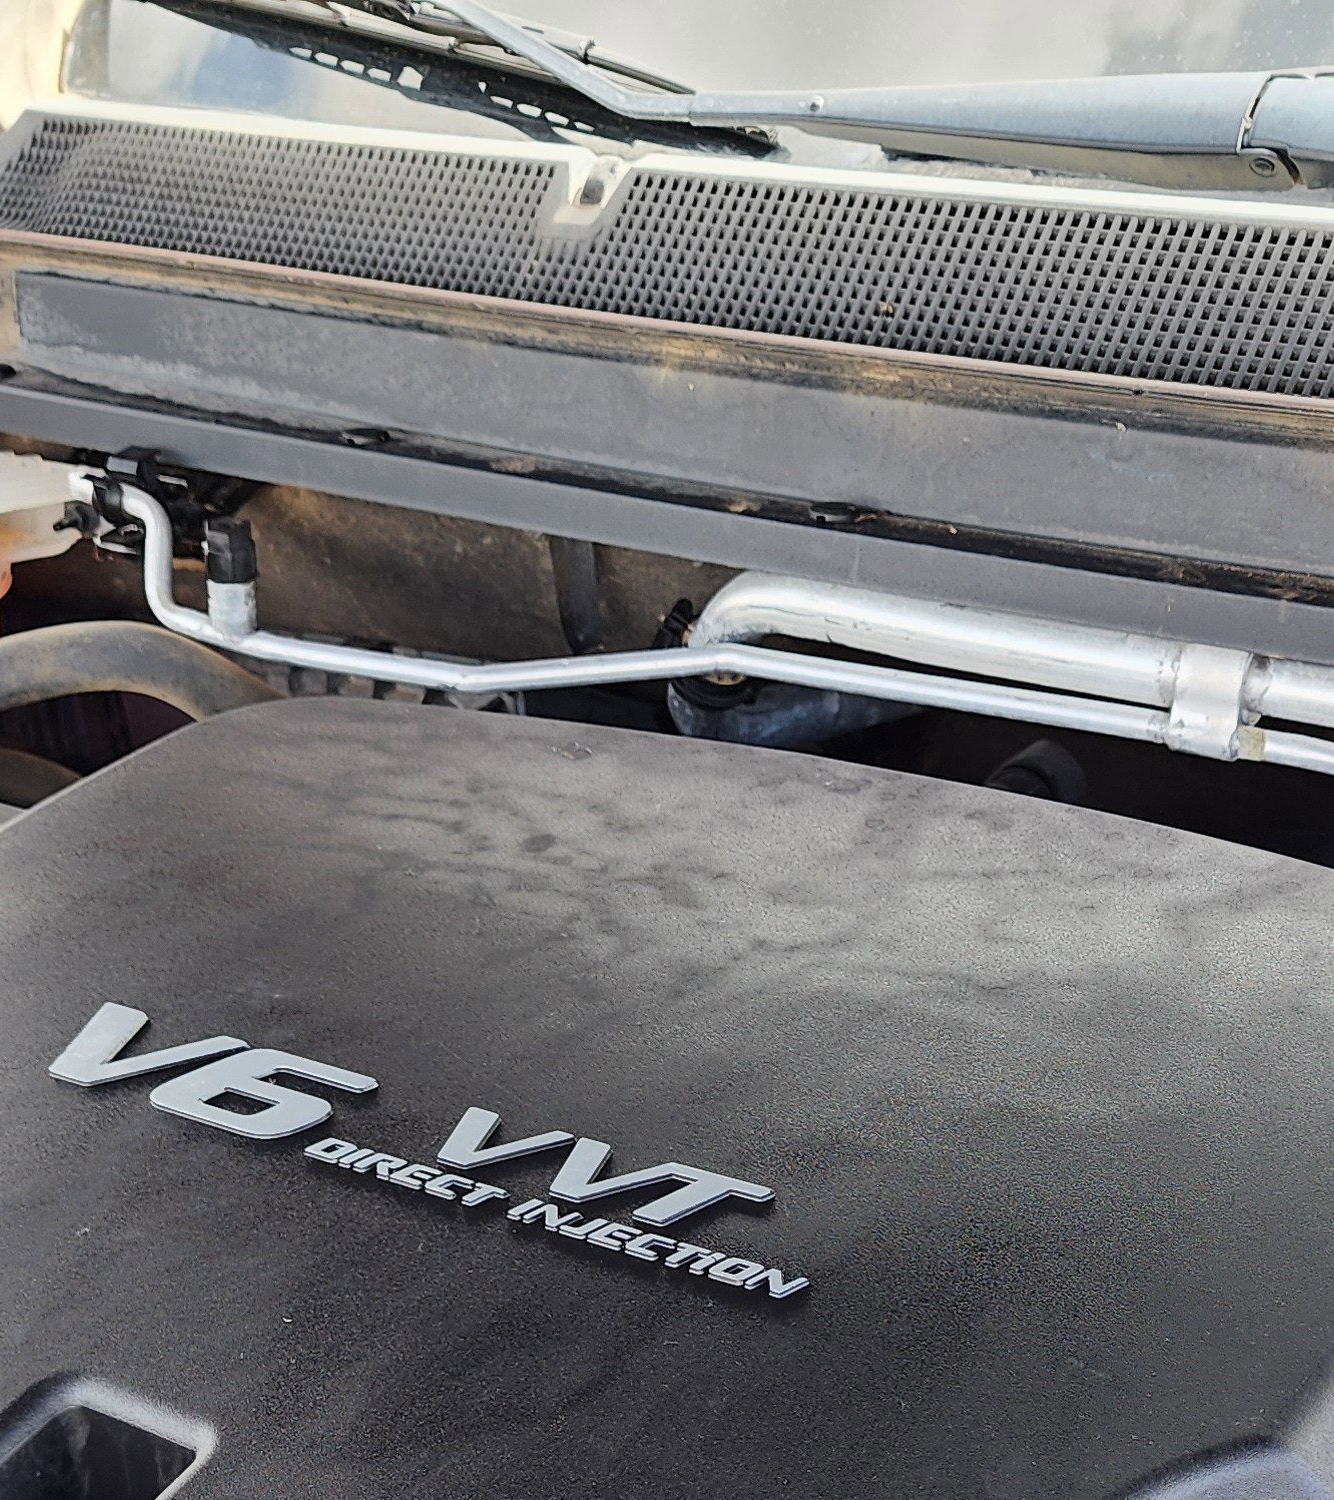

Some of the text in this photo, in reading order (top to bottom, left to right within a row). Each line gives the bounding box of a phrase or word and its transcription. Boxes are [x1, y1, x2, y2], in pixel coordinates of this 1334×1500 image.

[48, 1001, 776, 1227] V6 VVT
[303, 1137, 812, 1300] DIRECT INJECTION
